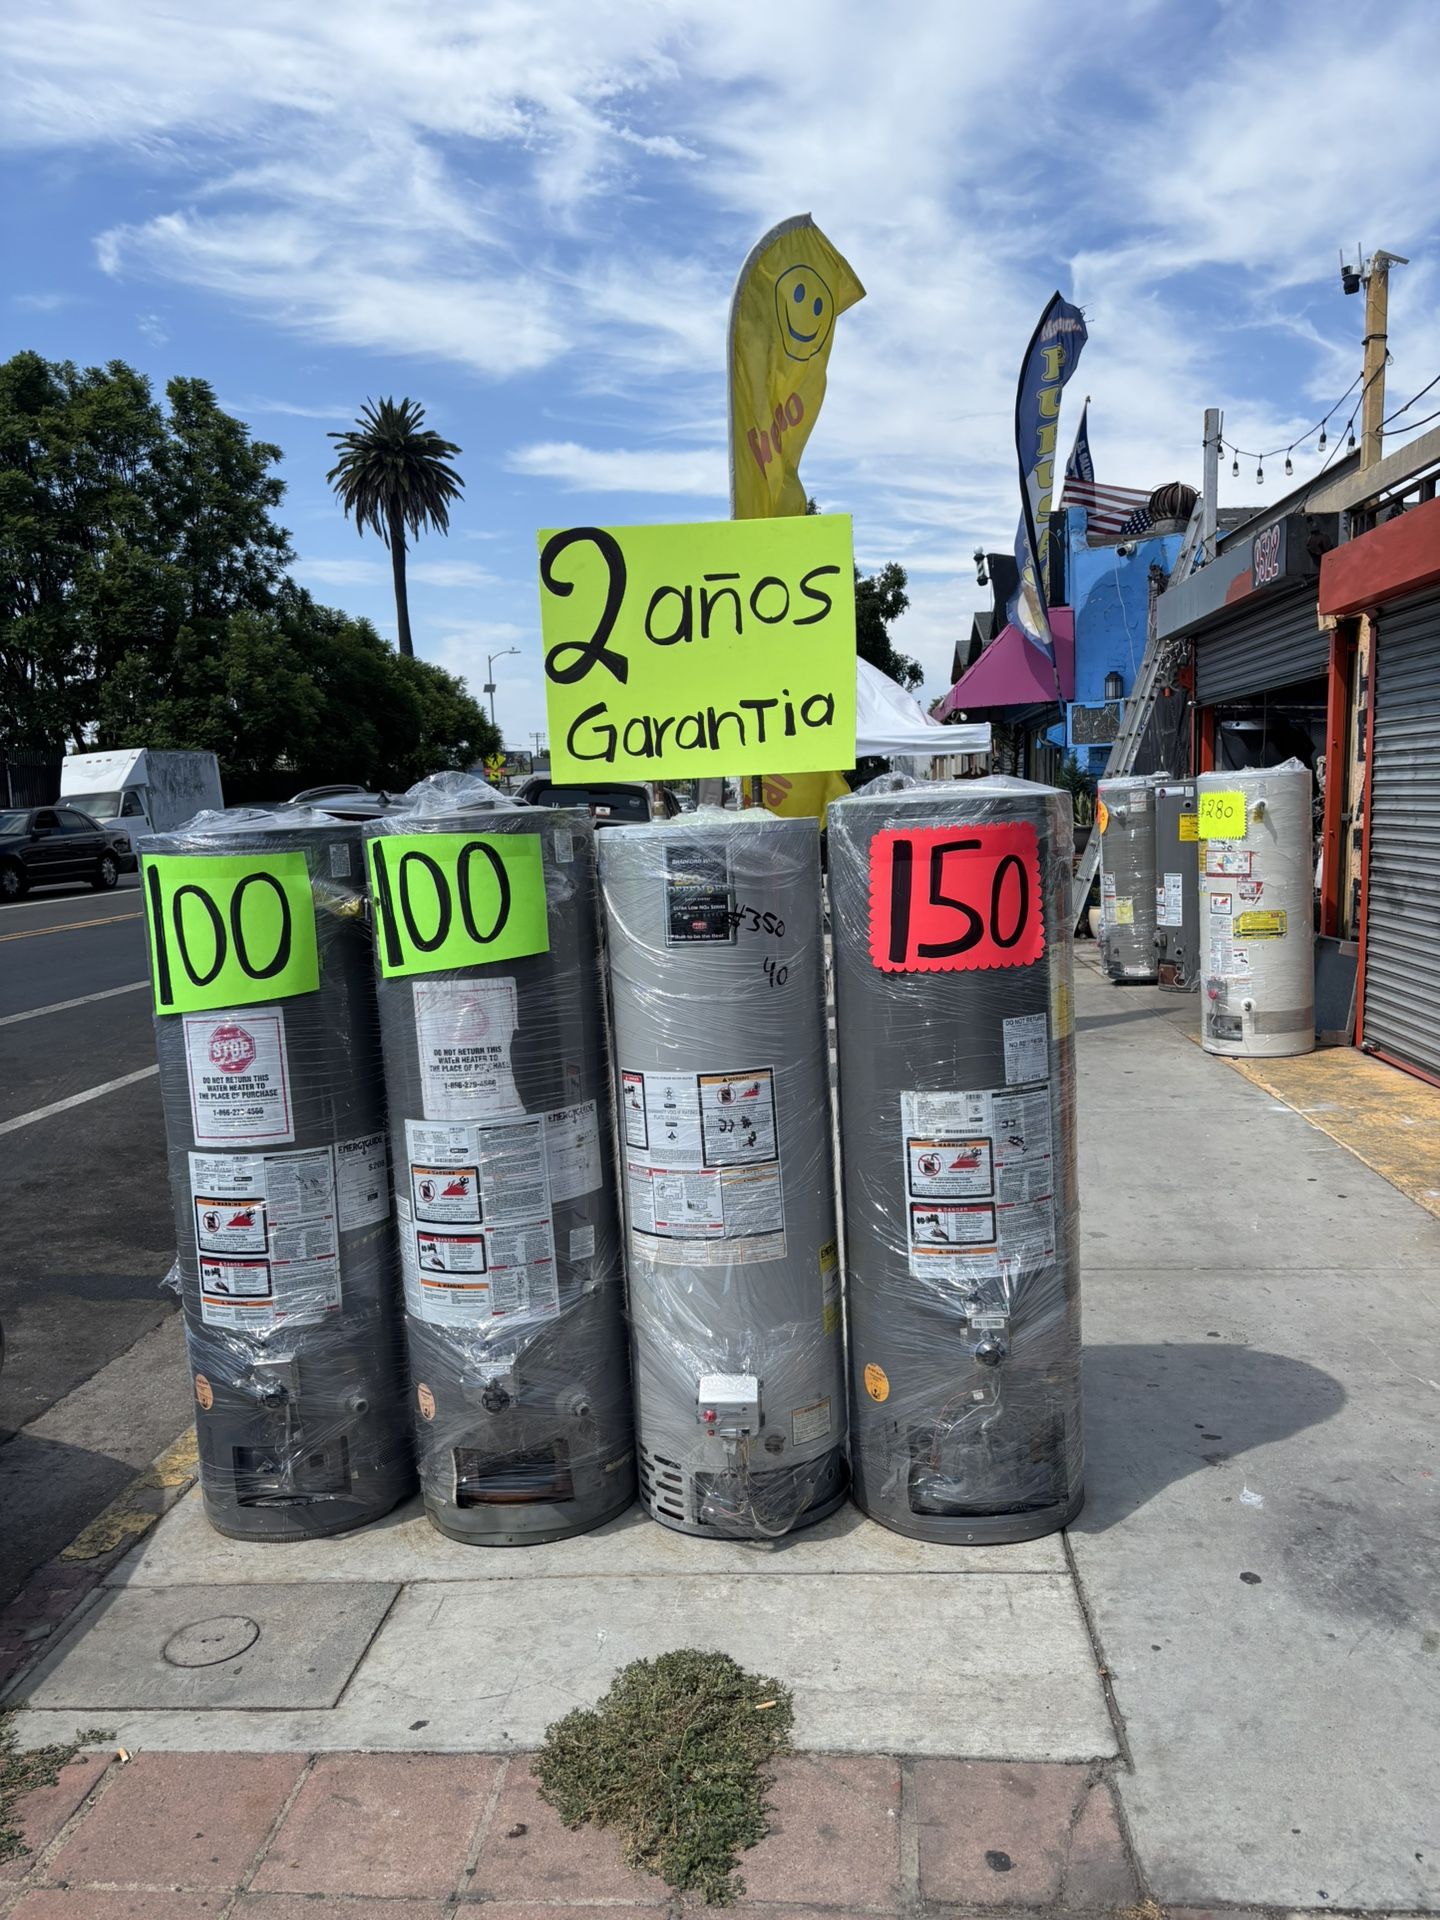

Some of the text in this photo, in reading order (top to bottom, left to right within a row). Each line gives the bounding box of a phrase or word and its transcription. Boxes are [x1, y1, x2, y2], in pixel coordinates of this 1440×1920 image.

[1254, 525, 1280, 586] 9522
[540, 527, 841, 685] 2 años
[373, 841, 511, 967] 100
[889, 839, 1029, 963] 150
[147, 864, 291, 1005] 100
[763, 956, 788, 988] 40
[212, 1038, 251, 1062] STOP
[438, 1056, 460, 1064] WATER
[461, 1055, 488, 1063] HEATER
[443, 1048, 456, 1056] NOT
[458, 1047, 485, 1055] RETURN
[487, 1045, 502, 1053] THIS
[212, 1076, 224, 1084] NOT
[225, 1075, 252, 1084] RETURN
[253, 1074, 270, 1082] THIS
[441, 1064, 462, 1072] PLACE
[199, 1092, 209, 1100] THE
[210, 1092, 230, 1100] PLACE
[241, 1088, 279, 1099] PURCHASE
[207, 1082, 266, 1092] WATER HEATER TO
